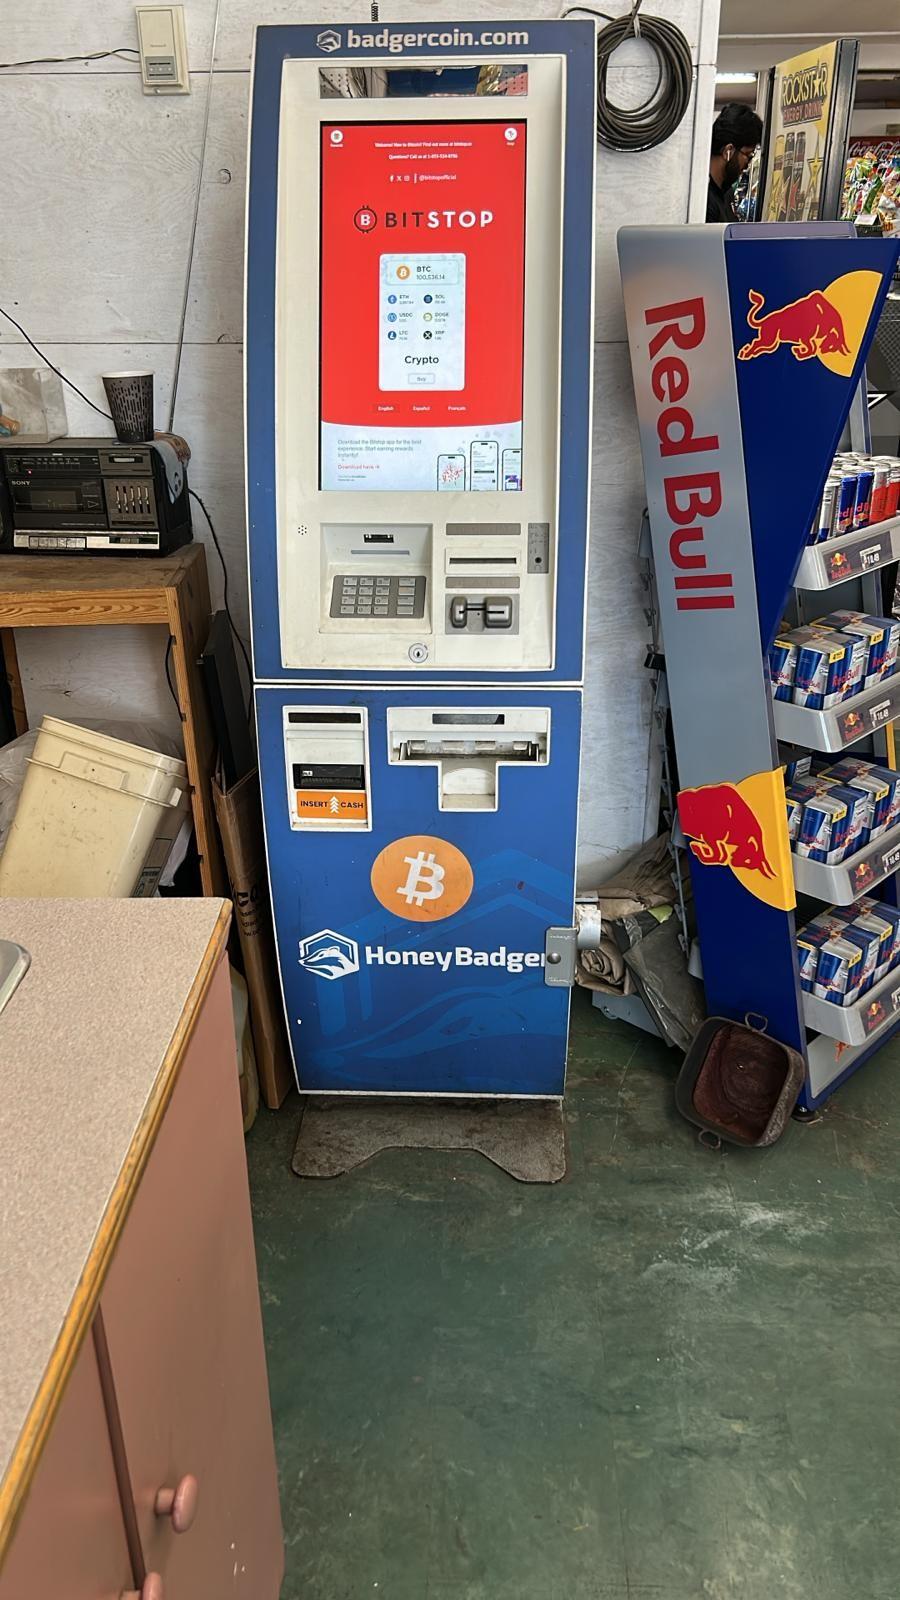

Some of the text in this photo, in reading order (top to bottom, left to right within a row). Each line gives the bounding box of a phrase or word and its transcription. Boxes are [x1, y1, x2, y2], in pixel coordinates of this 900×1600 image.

[347, 29, 529, 52] badgercoin.com
[783, 106, 803, 121] ENERGY
[385, 211, 494, 228] BITSTOP
[404, 355, 439, 365] Crypto
[644, 297, 735, 610] Red Bull
[832, 664, 861, 686] Red Bull
[300, 800, 364, 809] INSERT CASH
